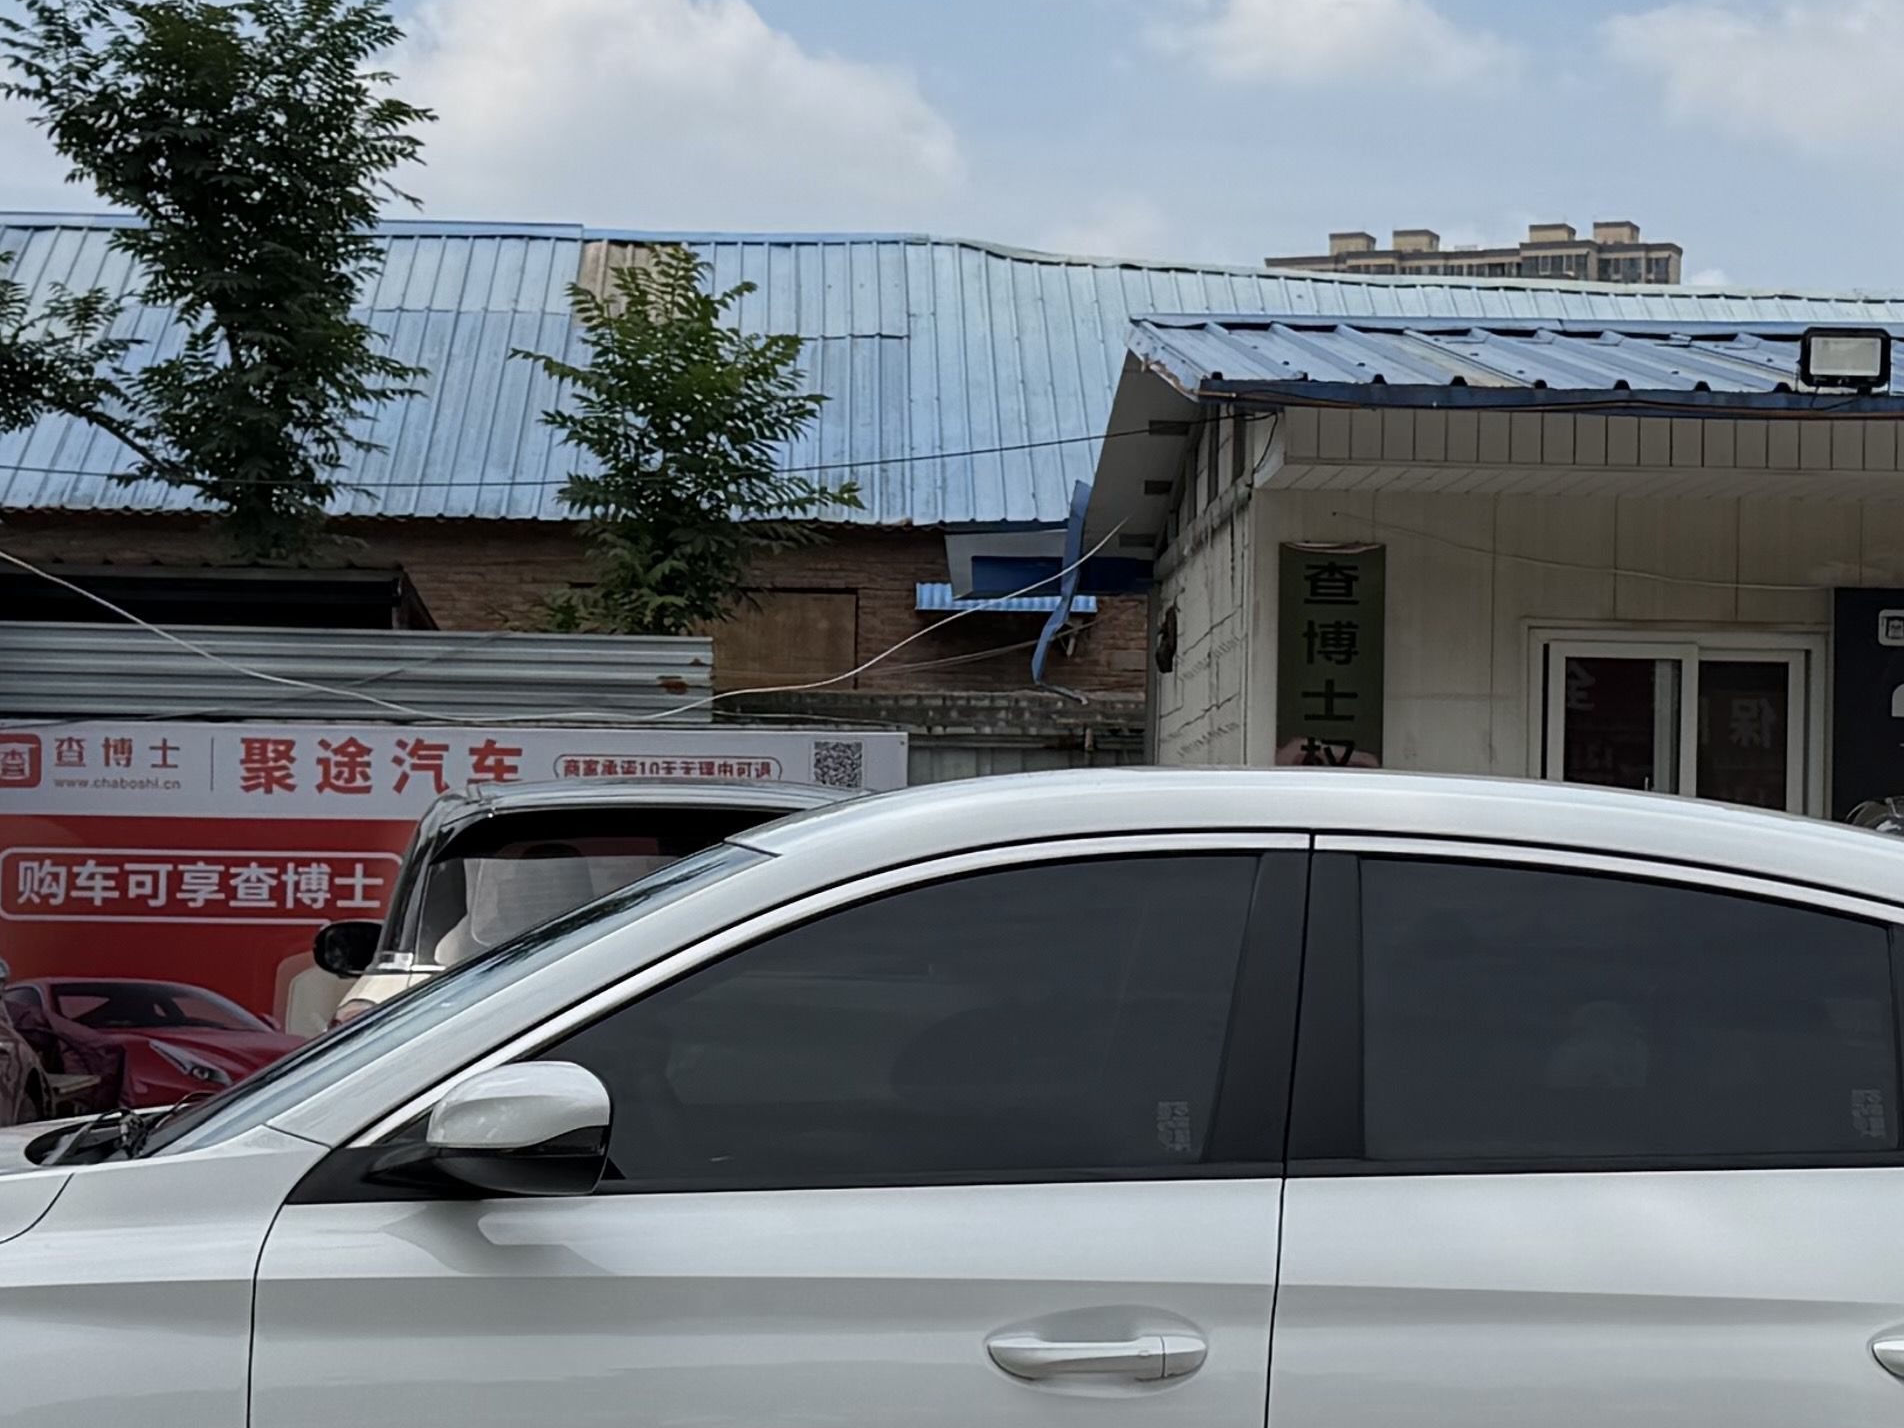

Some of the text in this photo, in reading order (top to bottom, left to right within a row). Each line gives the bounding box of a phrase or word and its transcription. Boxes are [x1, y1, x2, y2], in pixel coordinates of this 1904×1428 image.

[54, 736, 523, 795] 查博士 聚途汽车
[54, 777, 181, 790] www.chaboshi.cn
[16, 859, 385, 911] 购车可享查博士
